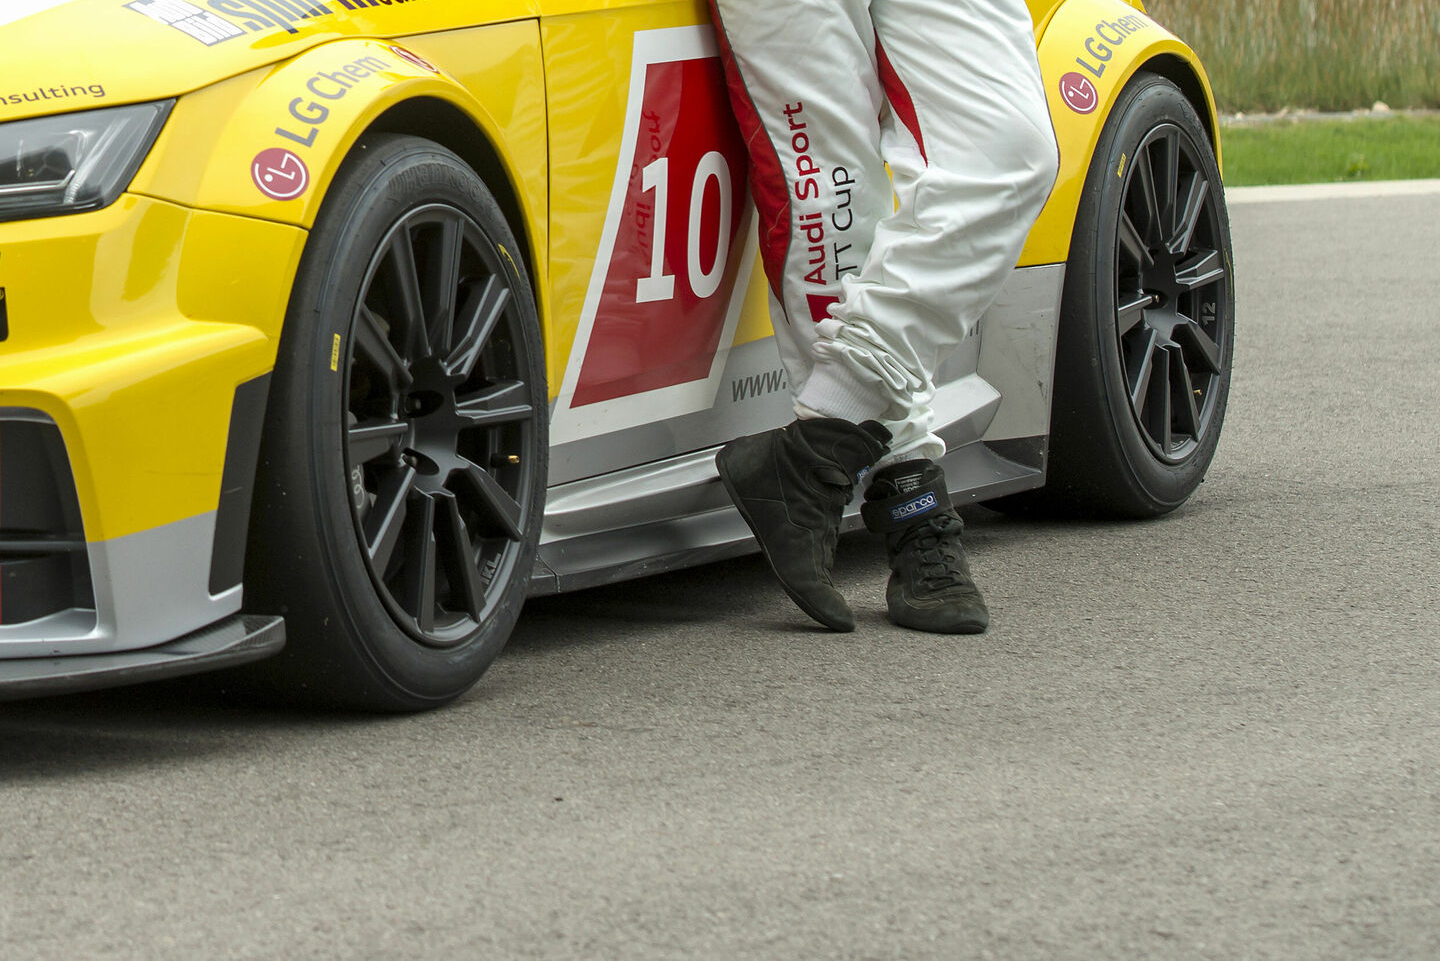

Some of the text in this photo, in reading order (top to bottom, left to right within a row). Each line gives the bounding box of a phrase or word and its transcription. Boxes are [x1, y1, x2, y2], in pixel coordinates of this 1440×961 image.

[1076, 14, 1148, 79] LG Chem
[274, 56, 391, 148] LG Chem
[635, 151, 733, 304] 10
[782, 101, 827, 286] Audi Sport
[832, 167, 858, 281] TT Cup
[892, 495, 934, 517] sparco
